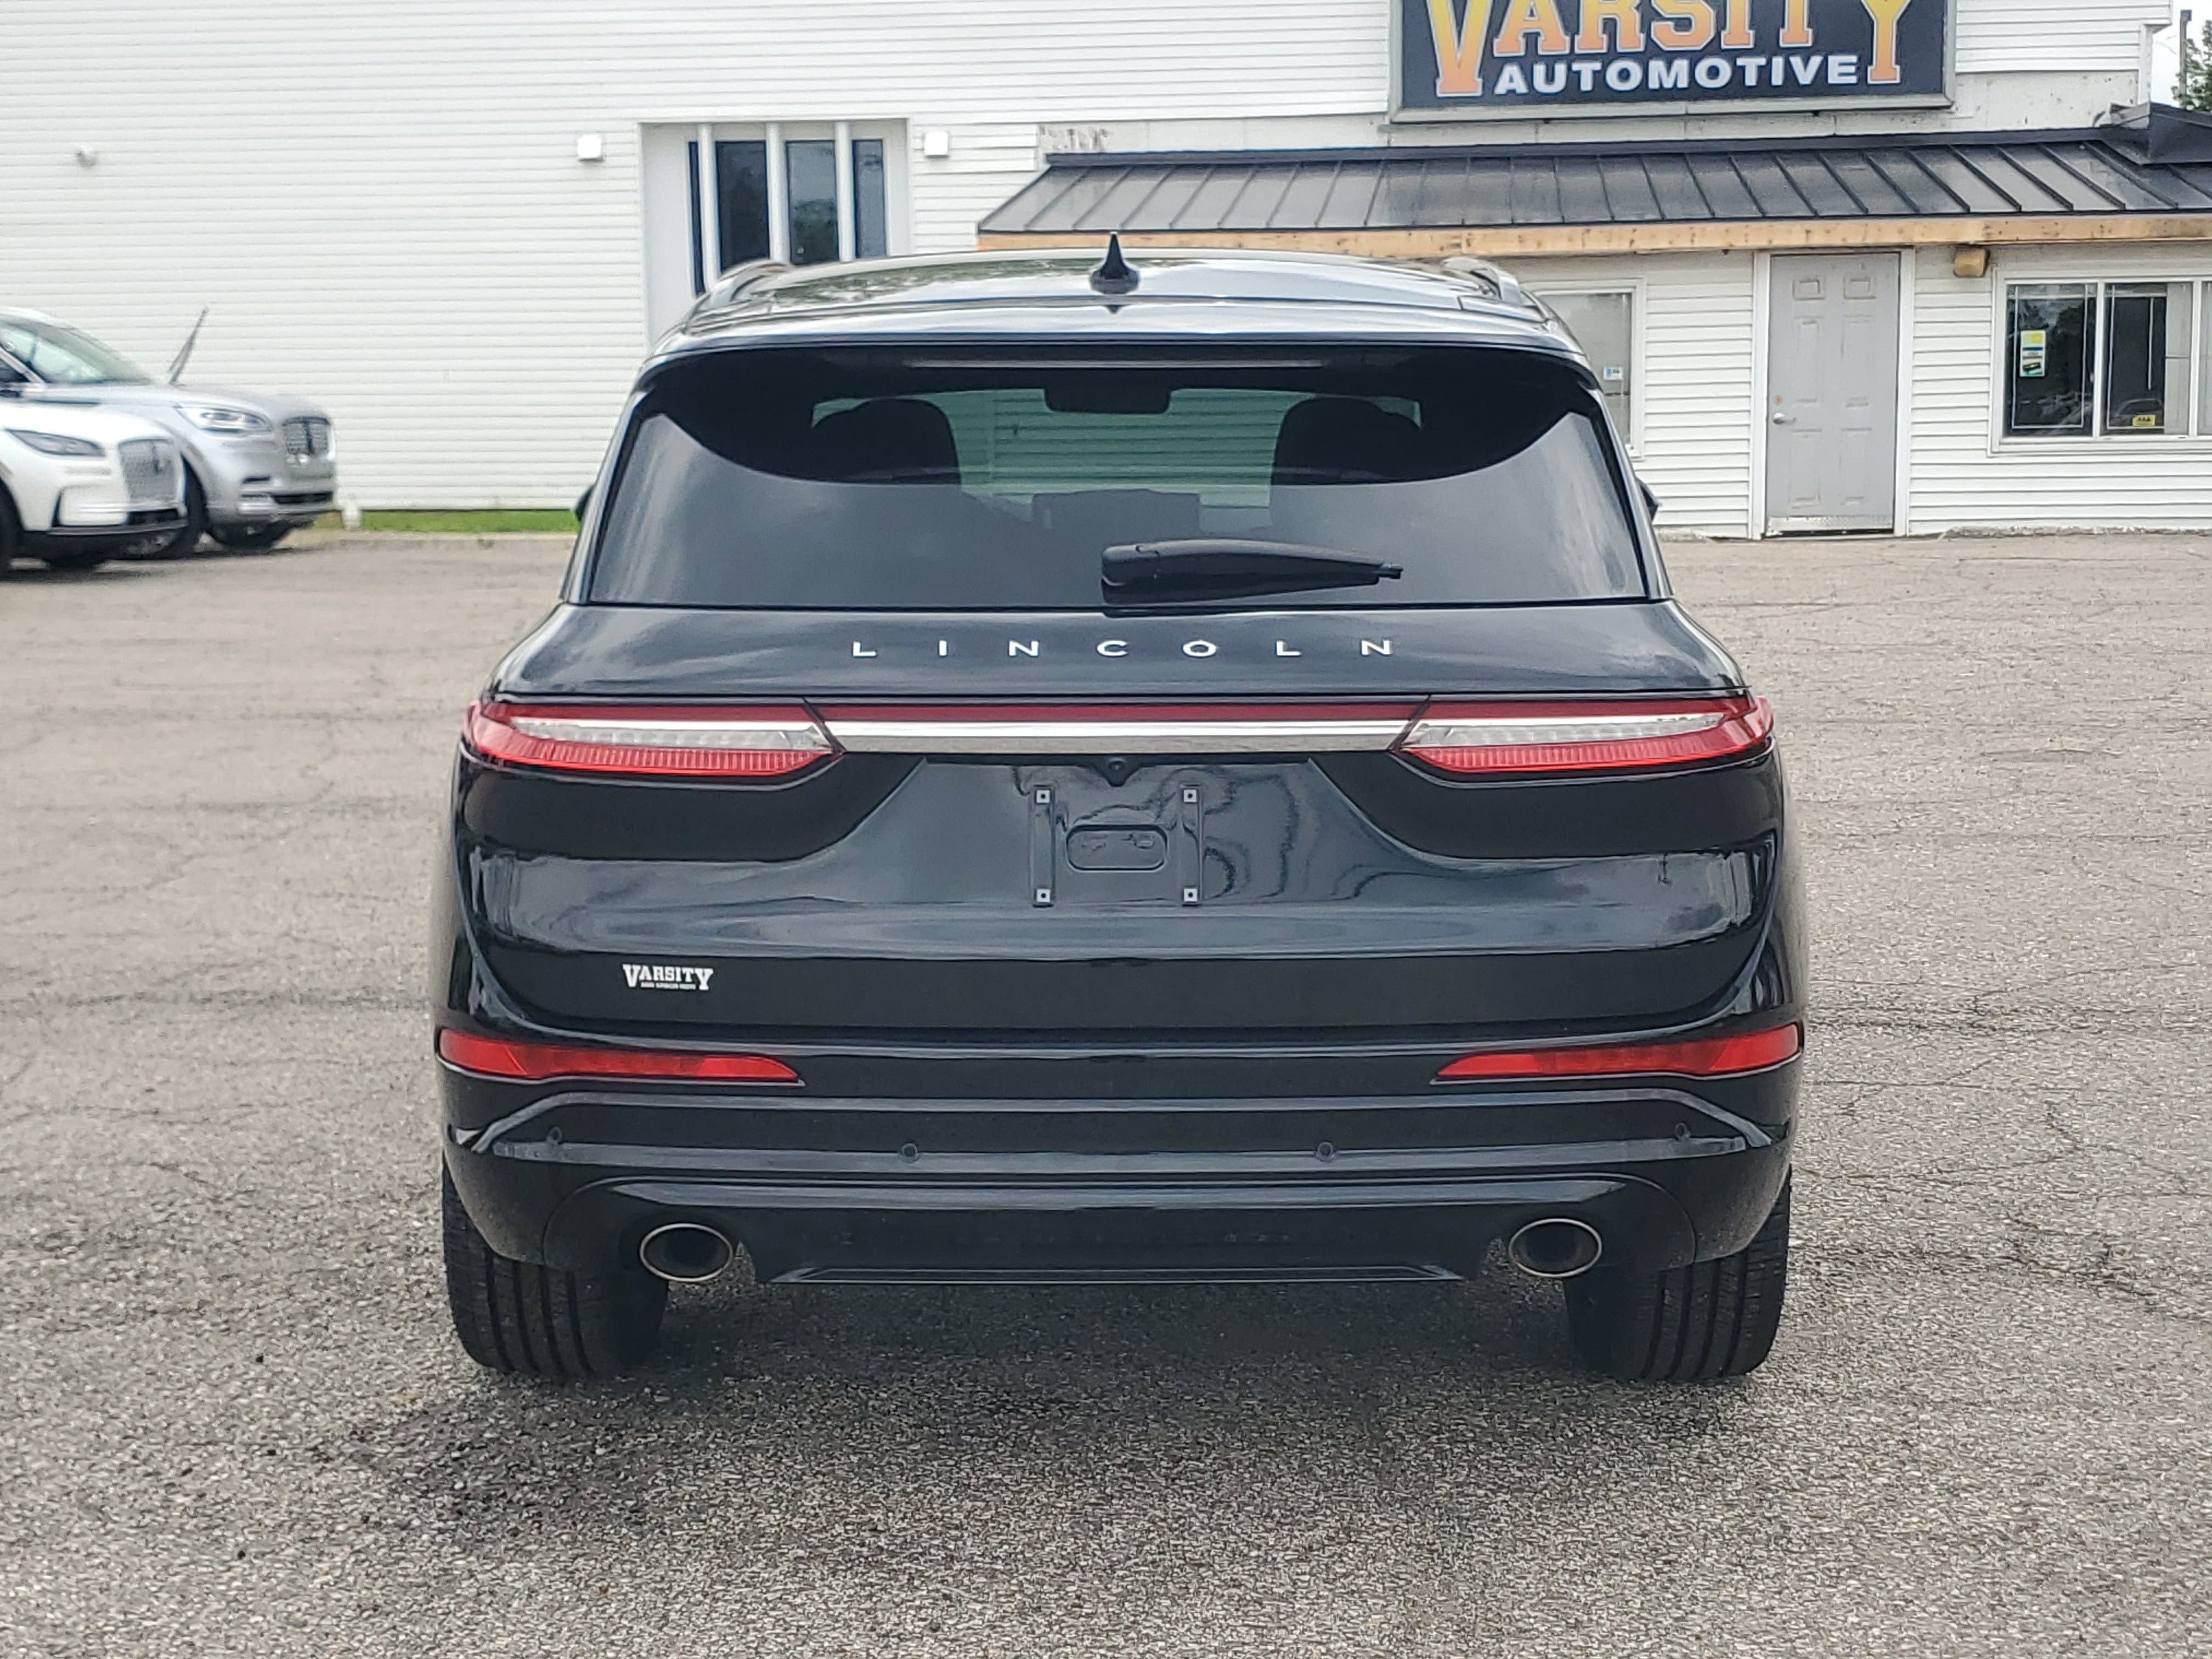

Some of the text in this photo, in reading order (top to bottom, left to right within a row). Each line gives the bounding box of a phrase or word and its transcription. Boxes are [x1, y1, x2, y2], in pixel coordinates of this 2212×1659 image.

[1426, 0, 1911, 97] VARSITY
[1493, 55, 1858, 95] AUTOMOTIVE
[853, 640, 1392, 657] LINCOLN
[622, 964, 714, 991] VARSITY
